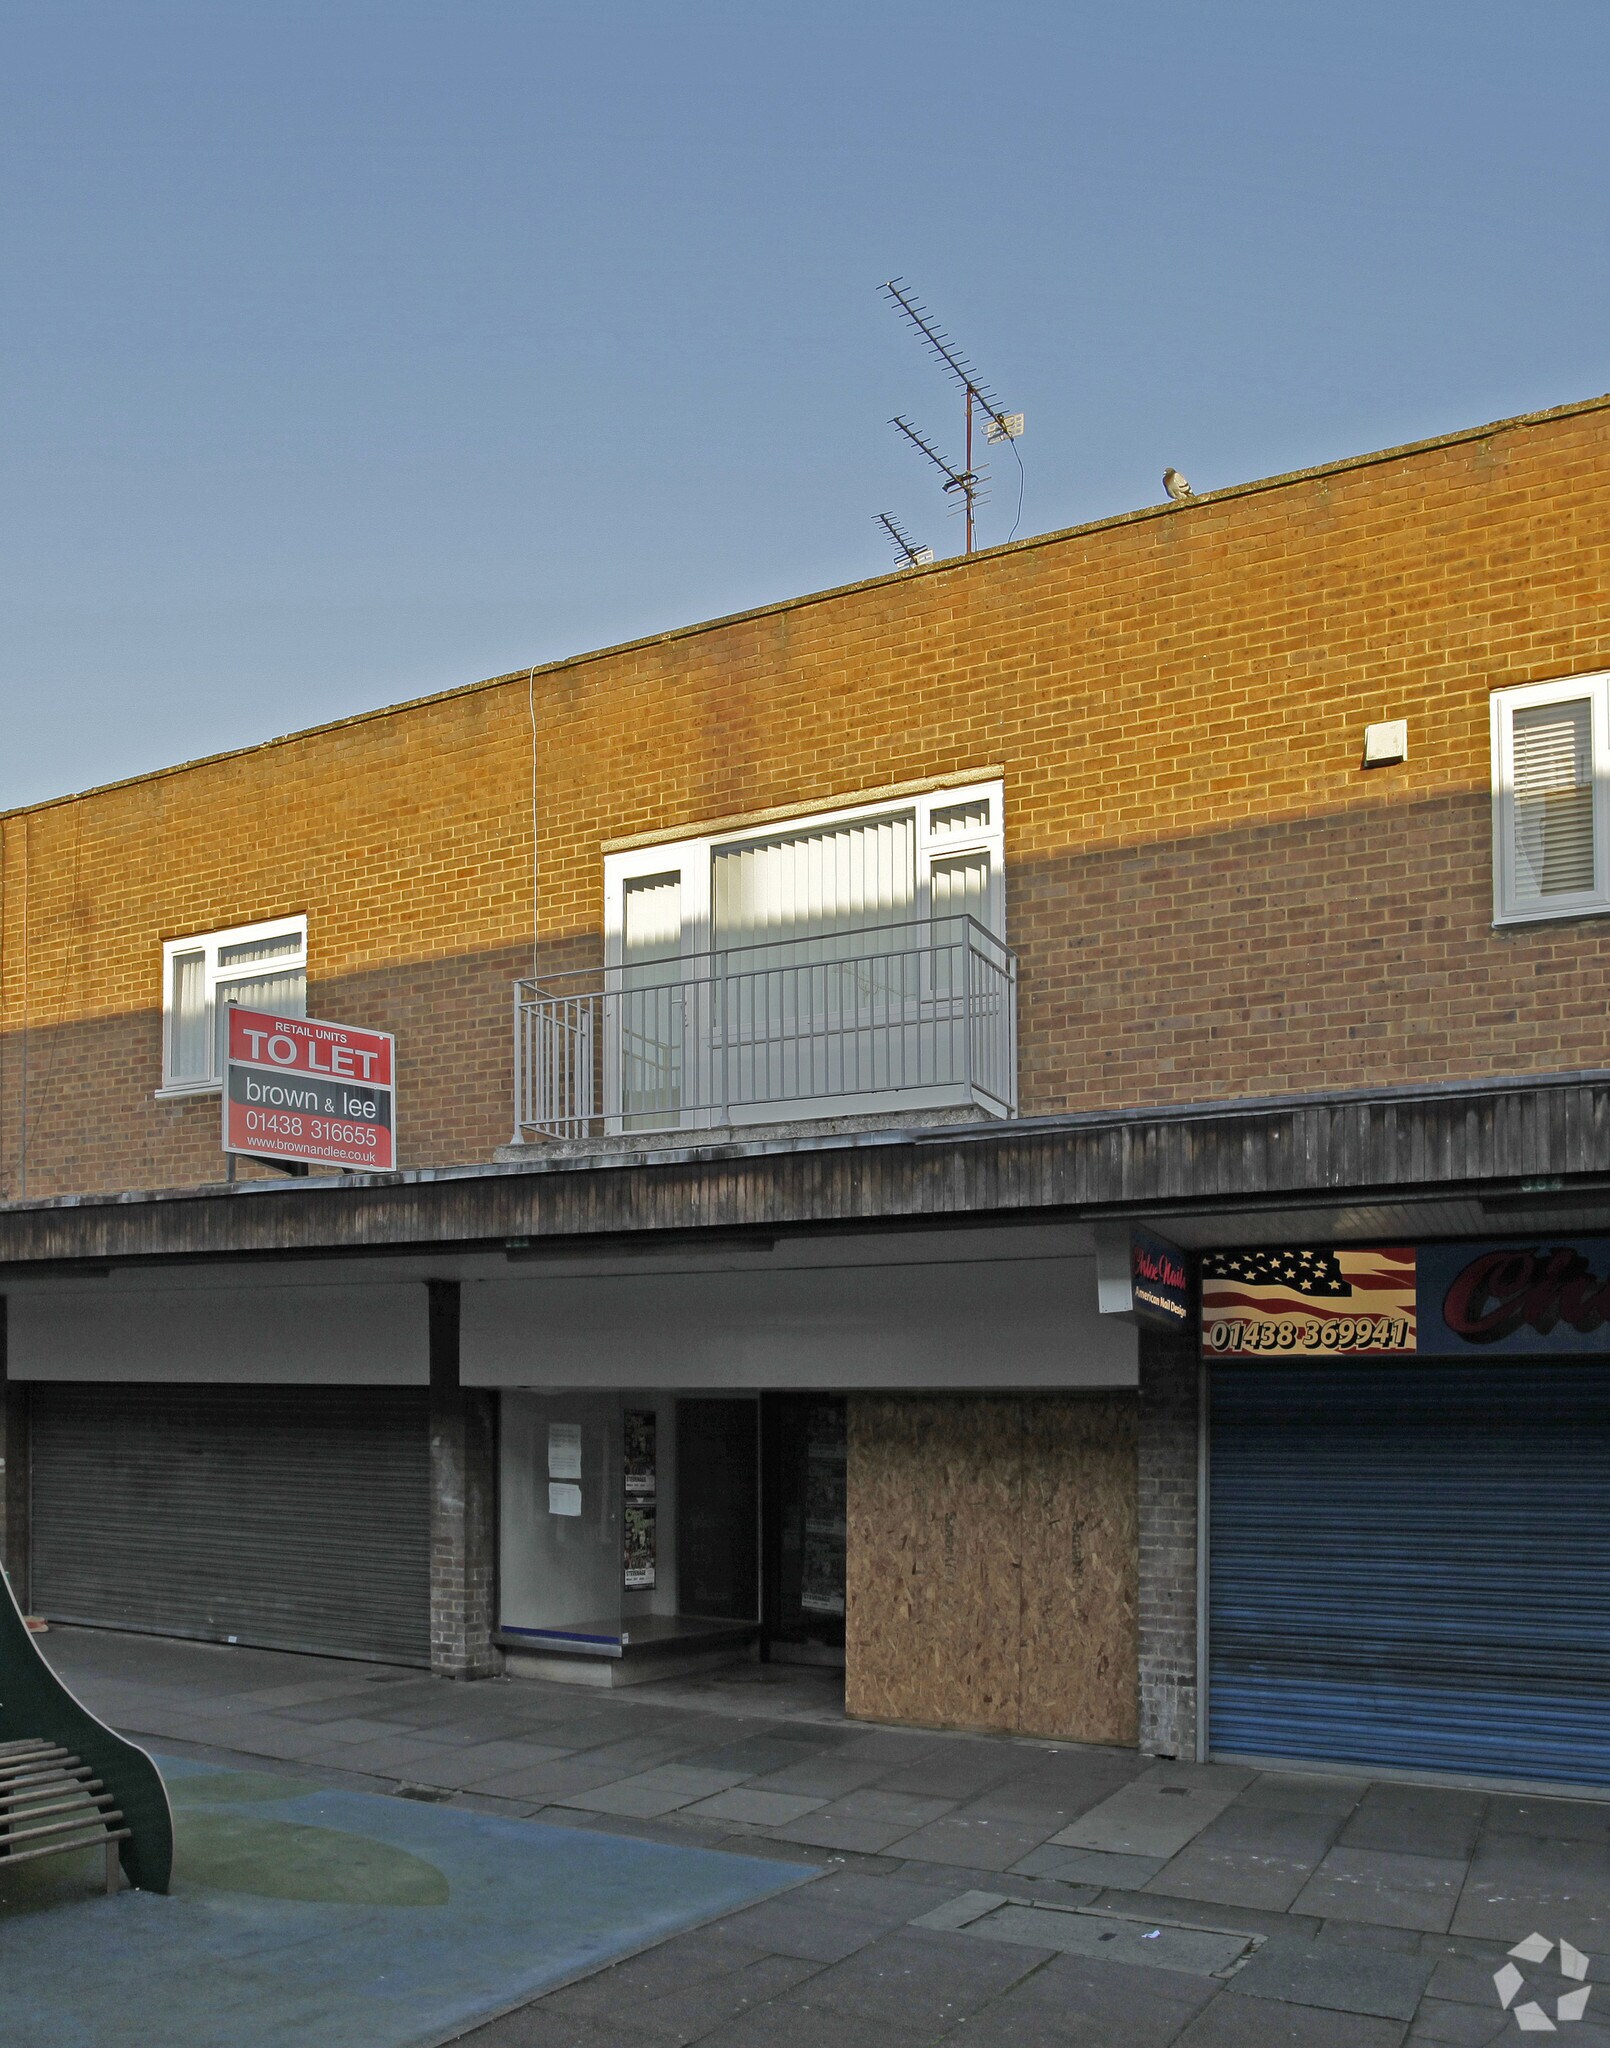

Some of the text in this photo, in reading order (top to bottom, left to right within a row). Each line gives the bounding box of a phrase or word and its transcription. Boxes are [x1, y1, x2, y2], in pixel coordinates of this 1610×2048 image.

[275, 1021, 348, 1044] RETAIL UNITS
[242, 1028, 378, 1079] TO LET
[246, 1076, 377, 1119] brown & lee
[246, 1110, 377, 1147] 01438 316655
[247, 1135, 376, 1162] www.brownandlee.co.uk
[1135, 1285, 1187, 1319] American Nail Design
[1210, 1317, 1409, 1352] 01438 369941
